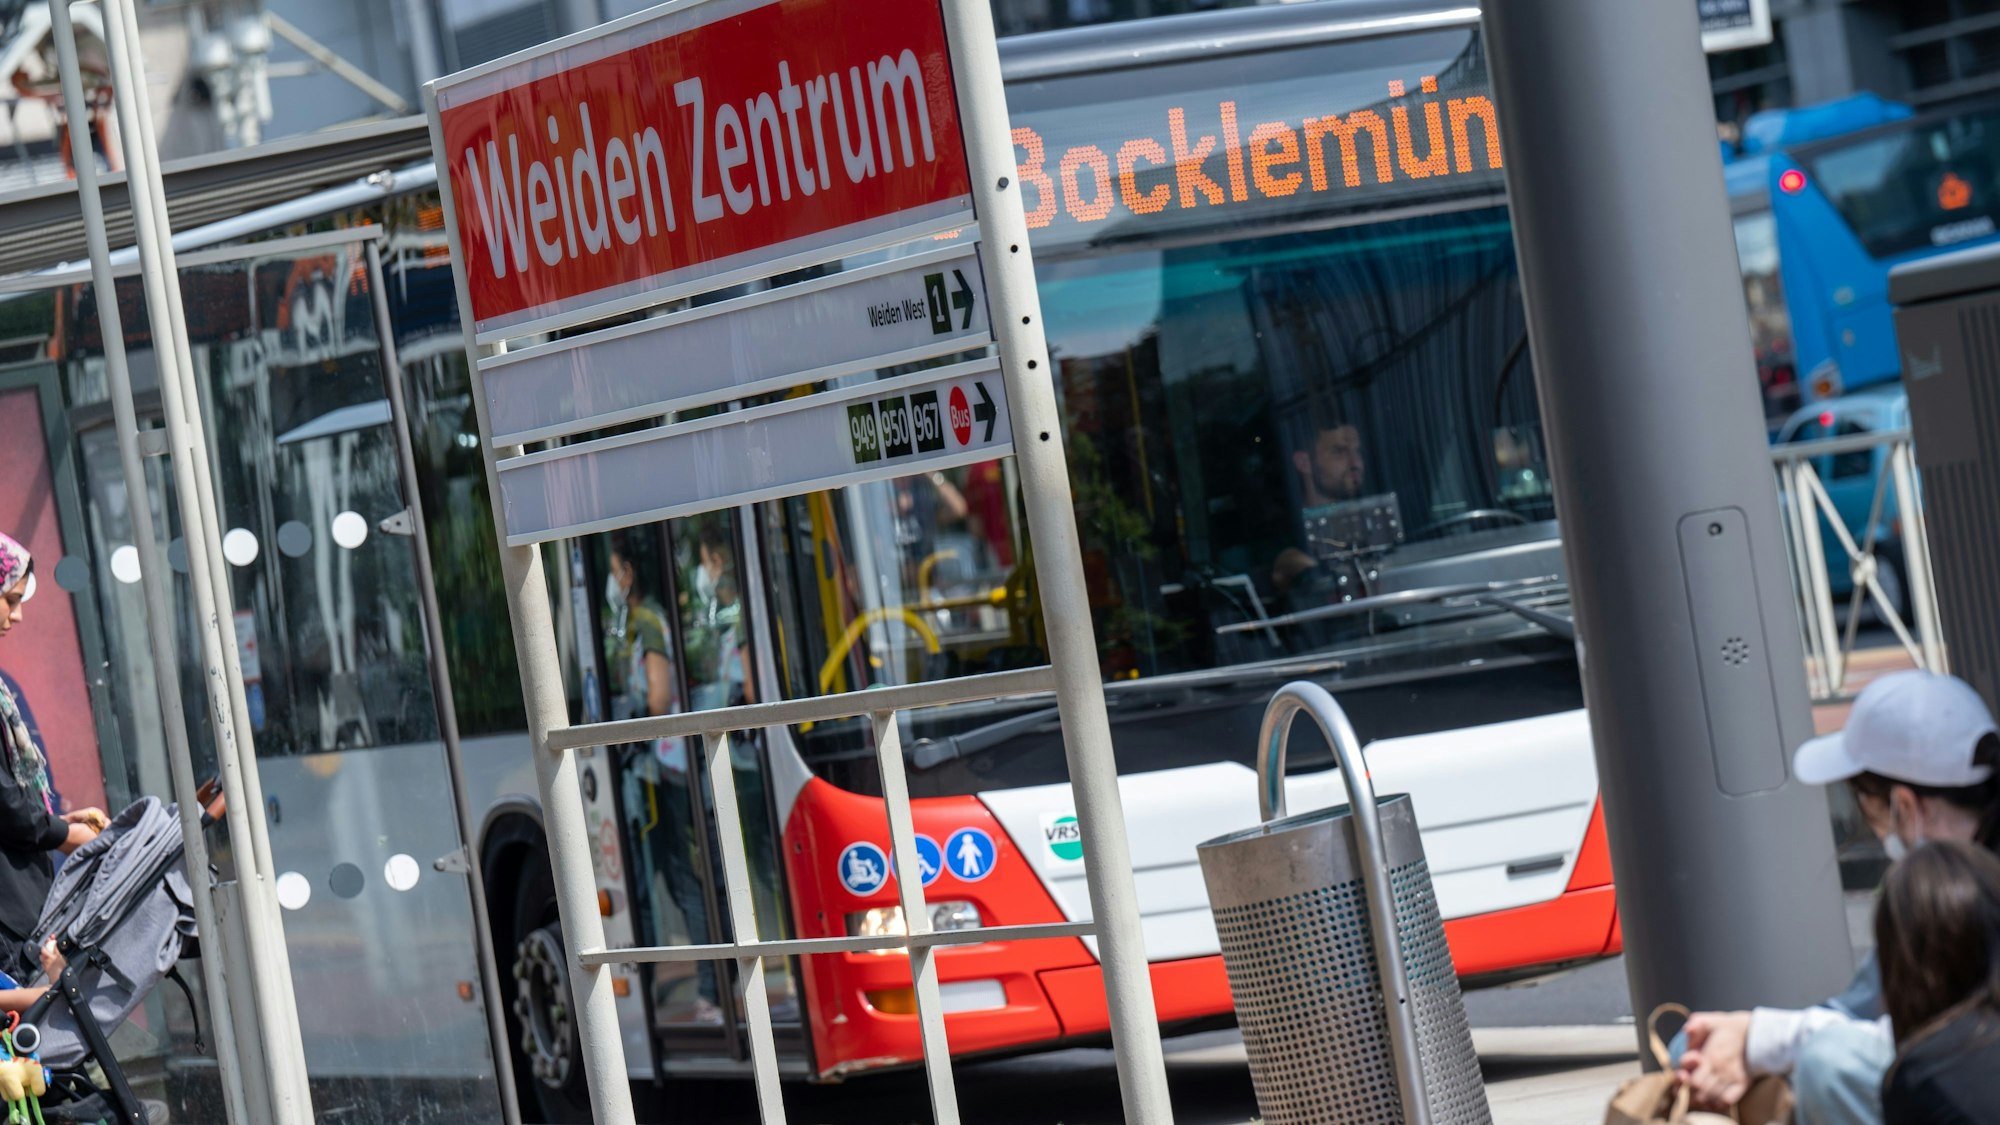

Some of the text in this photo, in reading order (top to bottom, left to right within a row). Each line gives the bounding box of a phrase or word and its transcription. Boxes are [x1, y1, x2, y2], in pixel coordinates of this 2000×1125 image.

[465, 48, 936, 279] Weiden Zentrum
[867, 284, 946, 328] Weiden West 1
[851, 402, 971, 453] 949 950 967 Bus
[1045, 824, 1079, 841] VRS
